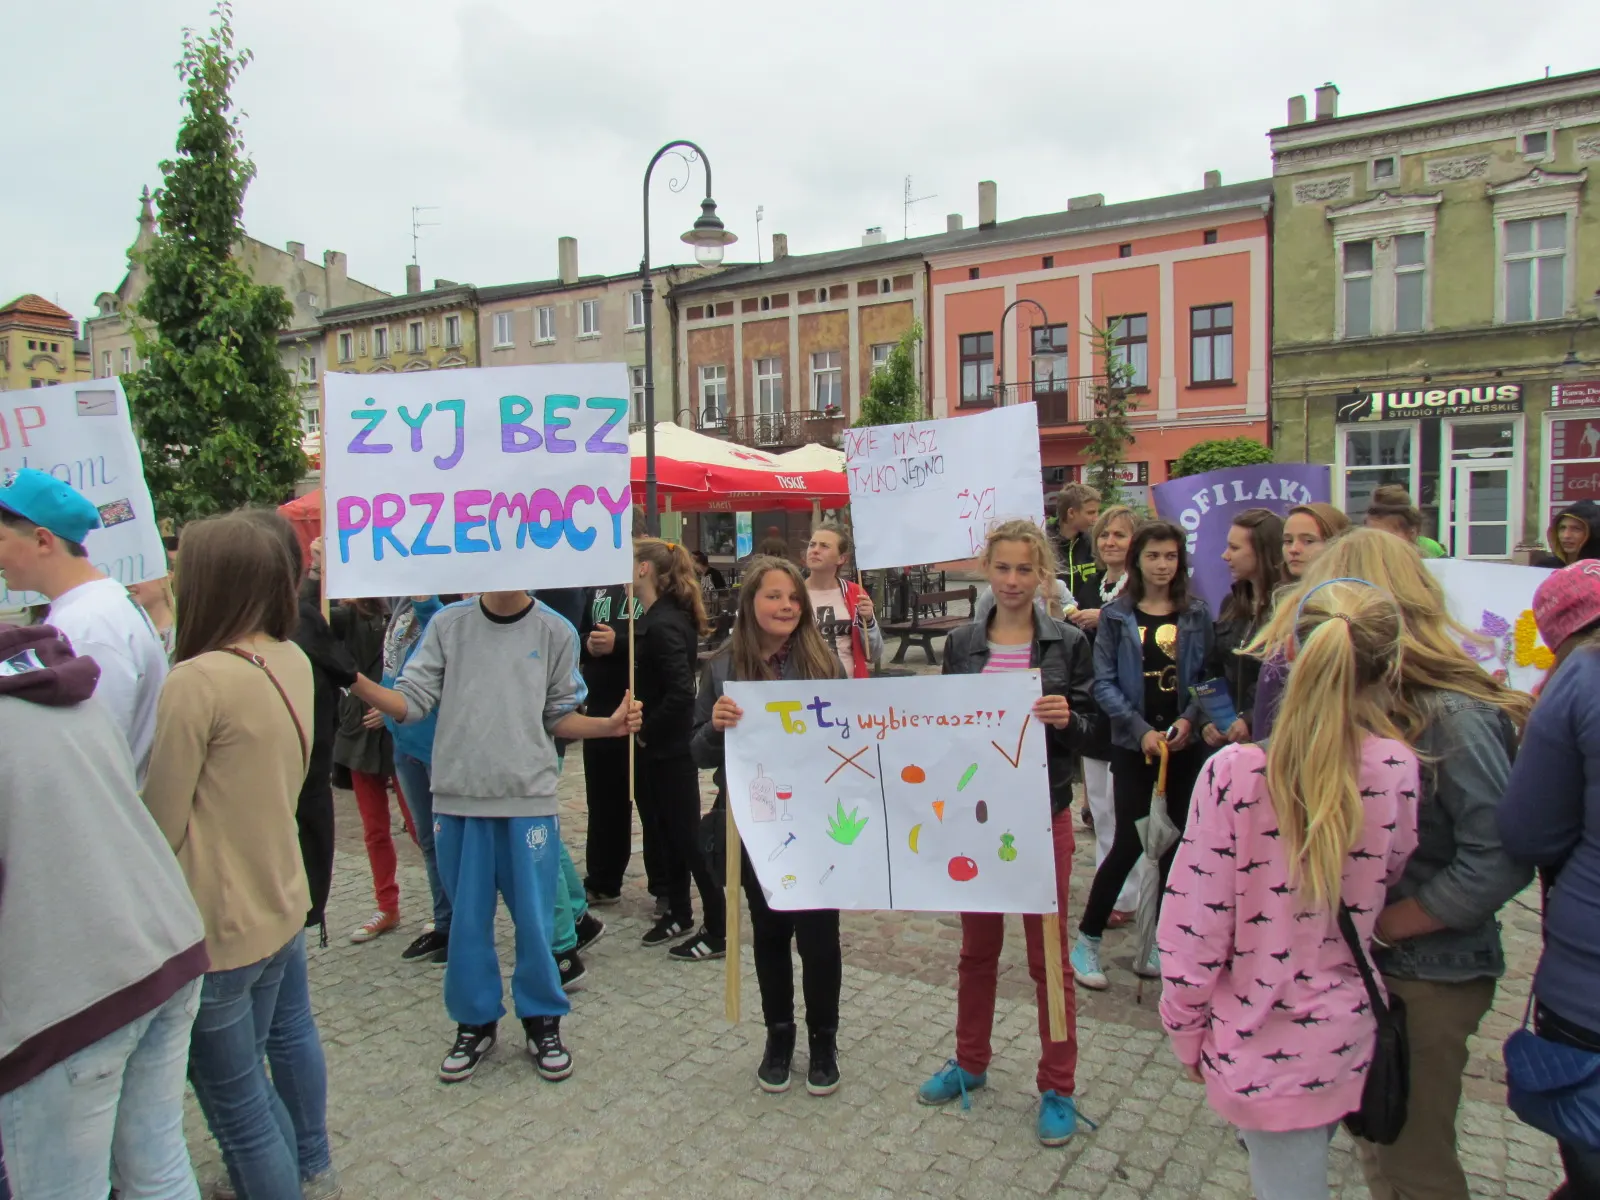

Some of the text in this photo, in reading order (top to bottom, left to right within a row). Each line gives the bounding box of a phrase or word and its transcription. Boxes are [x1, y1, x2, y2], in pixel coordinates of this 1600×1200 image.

[1388, 384, 1521, 409] wenus
[1388, 402, 1520, 418] STUDIO FRYZJERSKIE
[347, 393, 629, 471] ŻYJ BEZ
[893, 424, 938, 455] MASZ
[774, 474, 807, 490] TYSKIE
[849, 455, 945, 493] TYLKO JEDNO
[1568, 472, 1600, 492] caf
[336, 484, 632, 564] PRZEMOCY
[765, 700, 806, 735] To
[806, 695, 850, 739] ty
